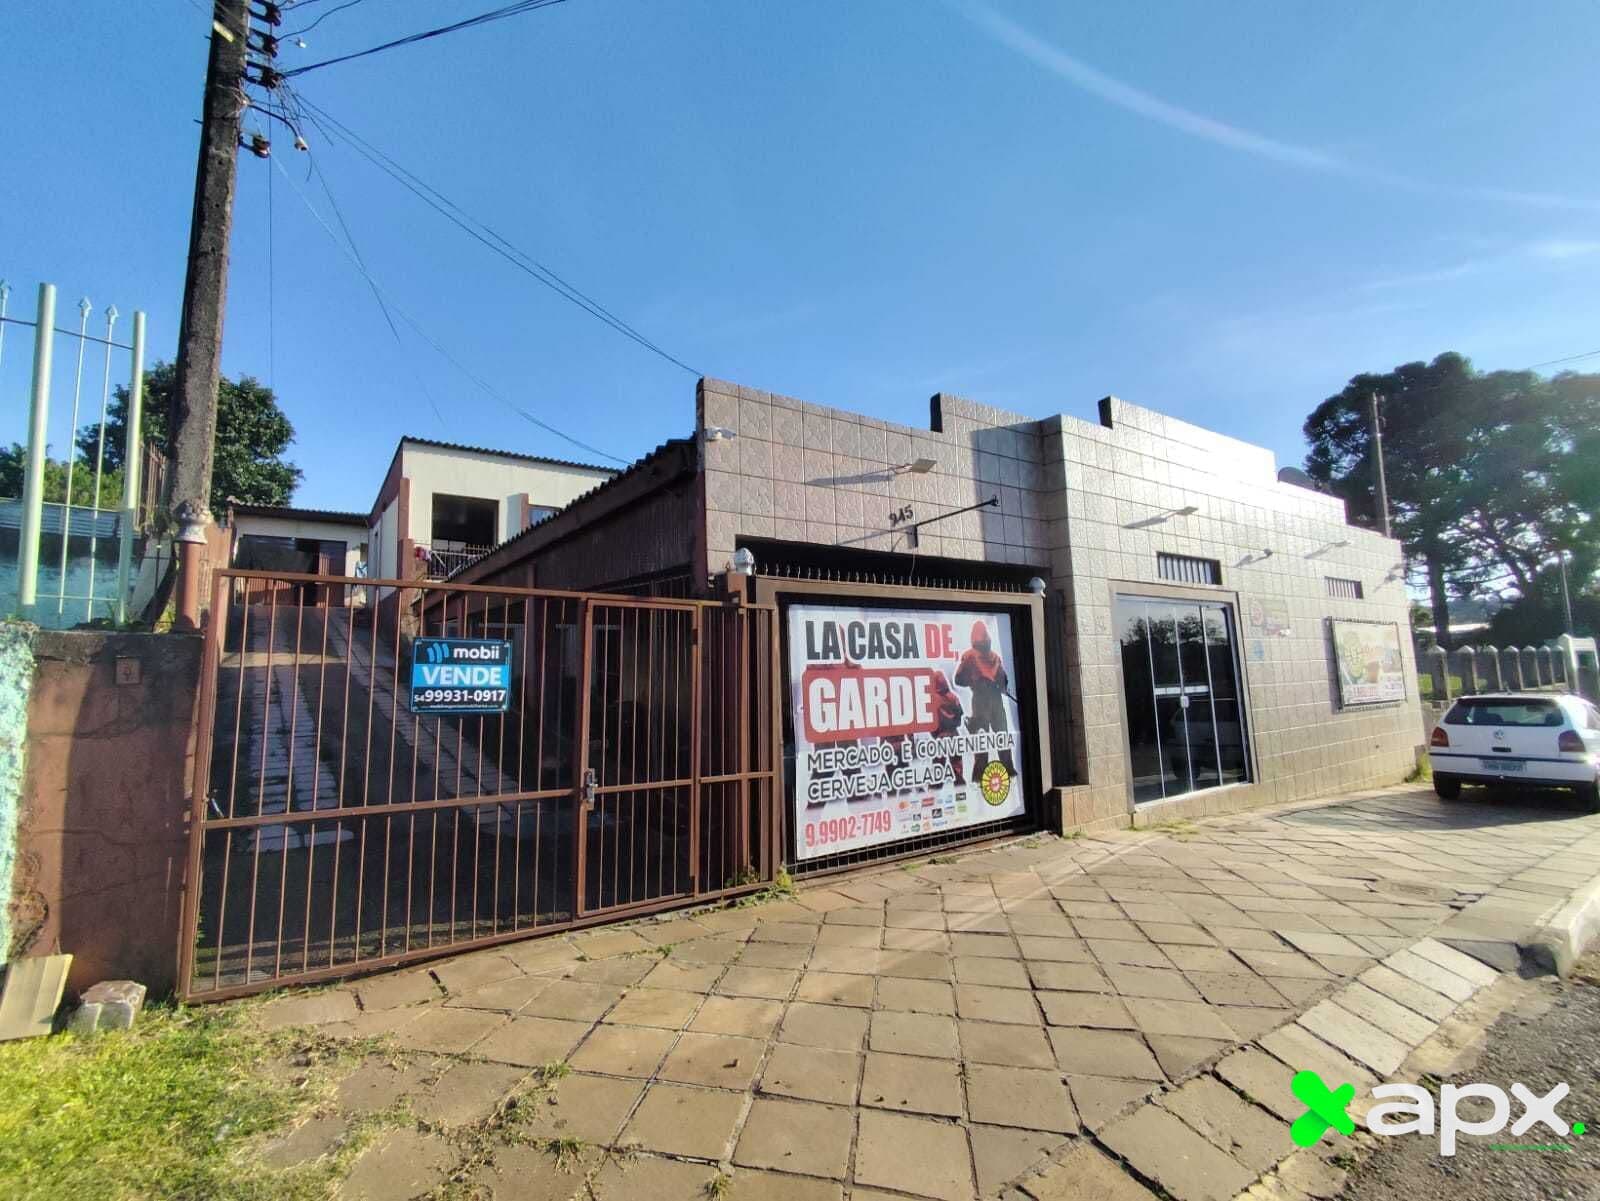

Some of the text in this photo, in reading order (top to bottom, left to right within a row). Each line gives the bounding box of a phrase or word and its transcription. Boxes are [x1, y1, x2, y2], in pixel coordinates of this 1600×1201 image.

[453, 645, 500, 660] mobii
[804, 620, 841, 661] LA
[847, 620, 921, 661] CASA
[422, 665, 502, 686] VENDE
[808, 674, 934, 733] GARDE
[903, 743, 912, 760] E
[917, 729, 1015, 759] CONVENIÊNCIA
[807, 764, 956, 801] CERVEJA GELADA
